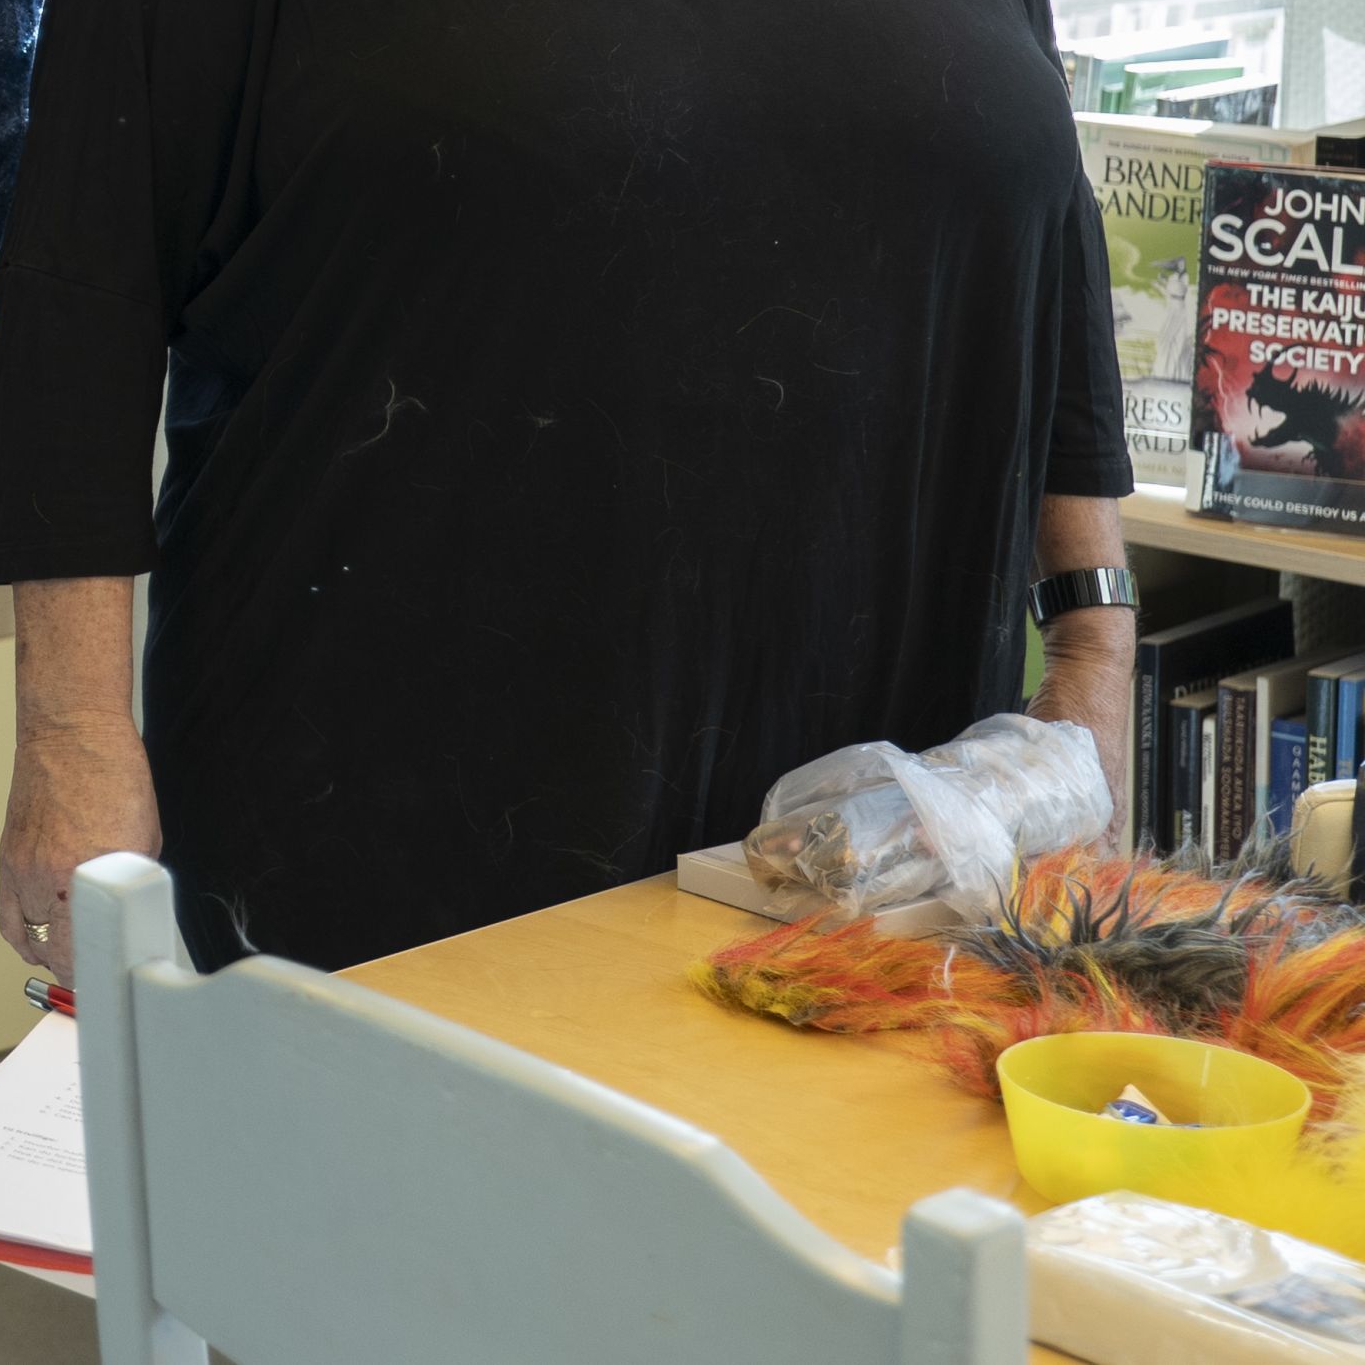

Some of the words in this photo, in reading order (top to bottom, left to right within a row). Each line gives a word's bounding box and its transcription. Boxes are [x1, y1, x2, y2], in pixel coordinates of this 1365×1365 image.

[1264, 188, 1365, 226] JOHN
[1209, 214, 1365, 276] SCAL
[1207, 265, 1225, 276] THE
[1227, 267, 1249, 279] NEW
[1252, 270, 1278, 281] YORK
[1280, 273, 1308, 284] TIMES
[1246, 283, 1295, 310] THE
[1302, 289, 1365, 323] KAIJU
[1212, 307, 1365, 347] PRESERVATI
[1249, 340, 1364, 375] SOCIETY
[1124, 391, 1182, 429] RESS
[1212, 491, 1241, 504] THEY
[1243, 495, 1284, 511] COULD
[1286, 502, 1339, 519] DESTROY
[1342, 508, 1357, 522] US
